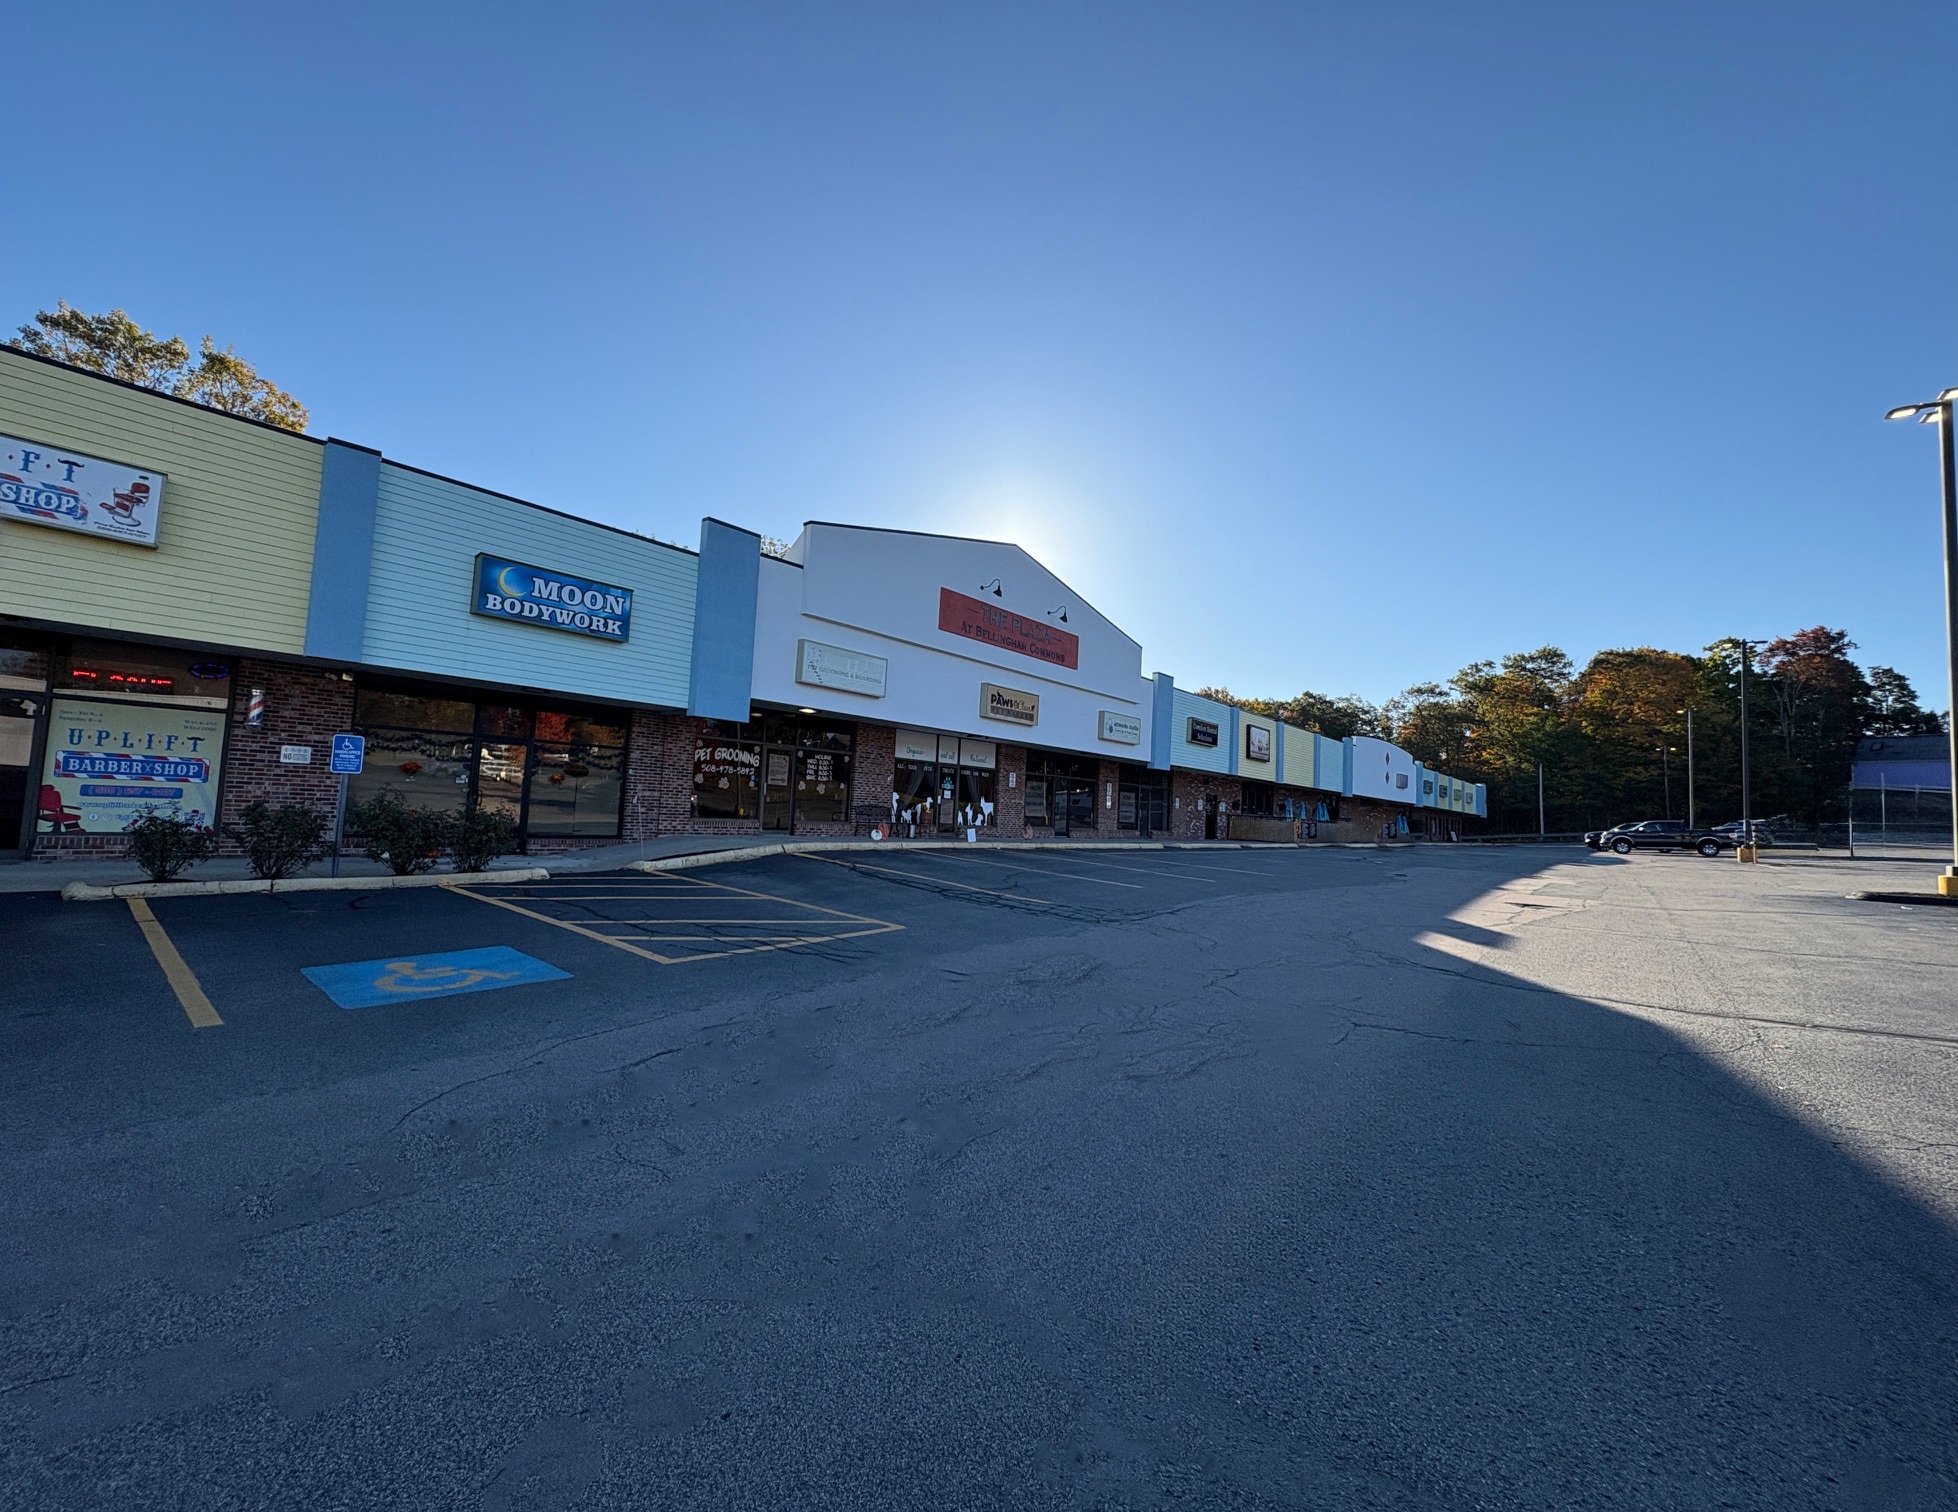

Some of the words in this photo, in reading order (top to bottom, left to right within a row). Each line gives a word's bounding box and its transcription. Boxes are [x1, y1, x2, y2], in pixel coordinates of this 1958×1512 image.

[0, 483, 77, 512] SHOP
[531, 577, 625, 615] MOON
[485, 593, 623, 636] BODYWORK
[981, 605, 1008, 630] THE
[1011, 617, 1051, 644] PLAZA
[818, 666, 849, 678] GROOMING
[855, 673, 882, 685] BOARDING
[991, 692, 1013, 708] PAWS
[283, 752, 292, 760] NO
[694, 747, 713, 763] PET
[714, 747, 760, 767] GROOMING
[68, 758, 144, 773] BARBER
[153, 762, 199, 776] SHOP
